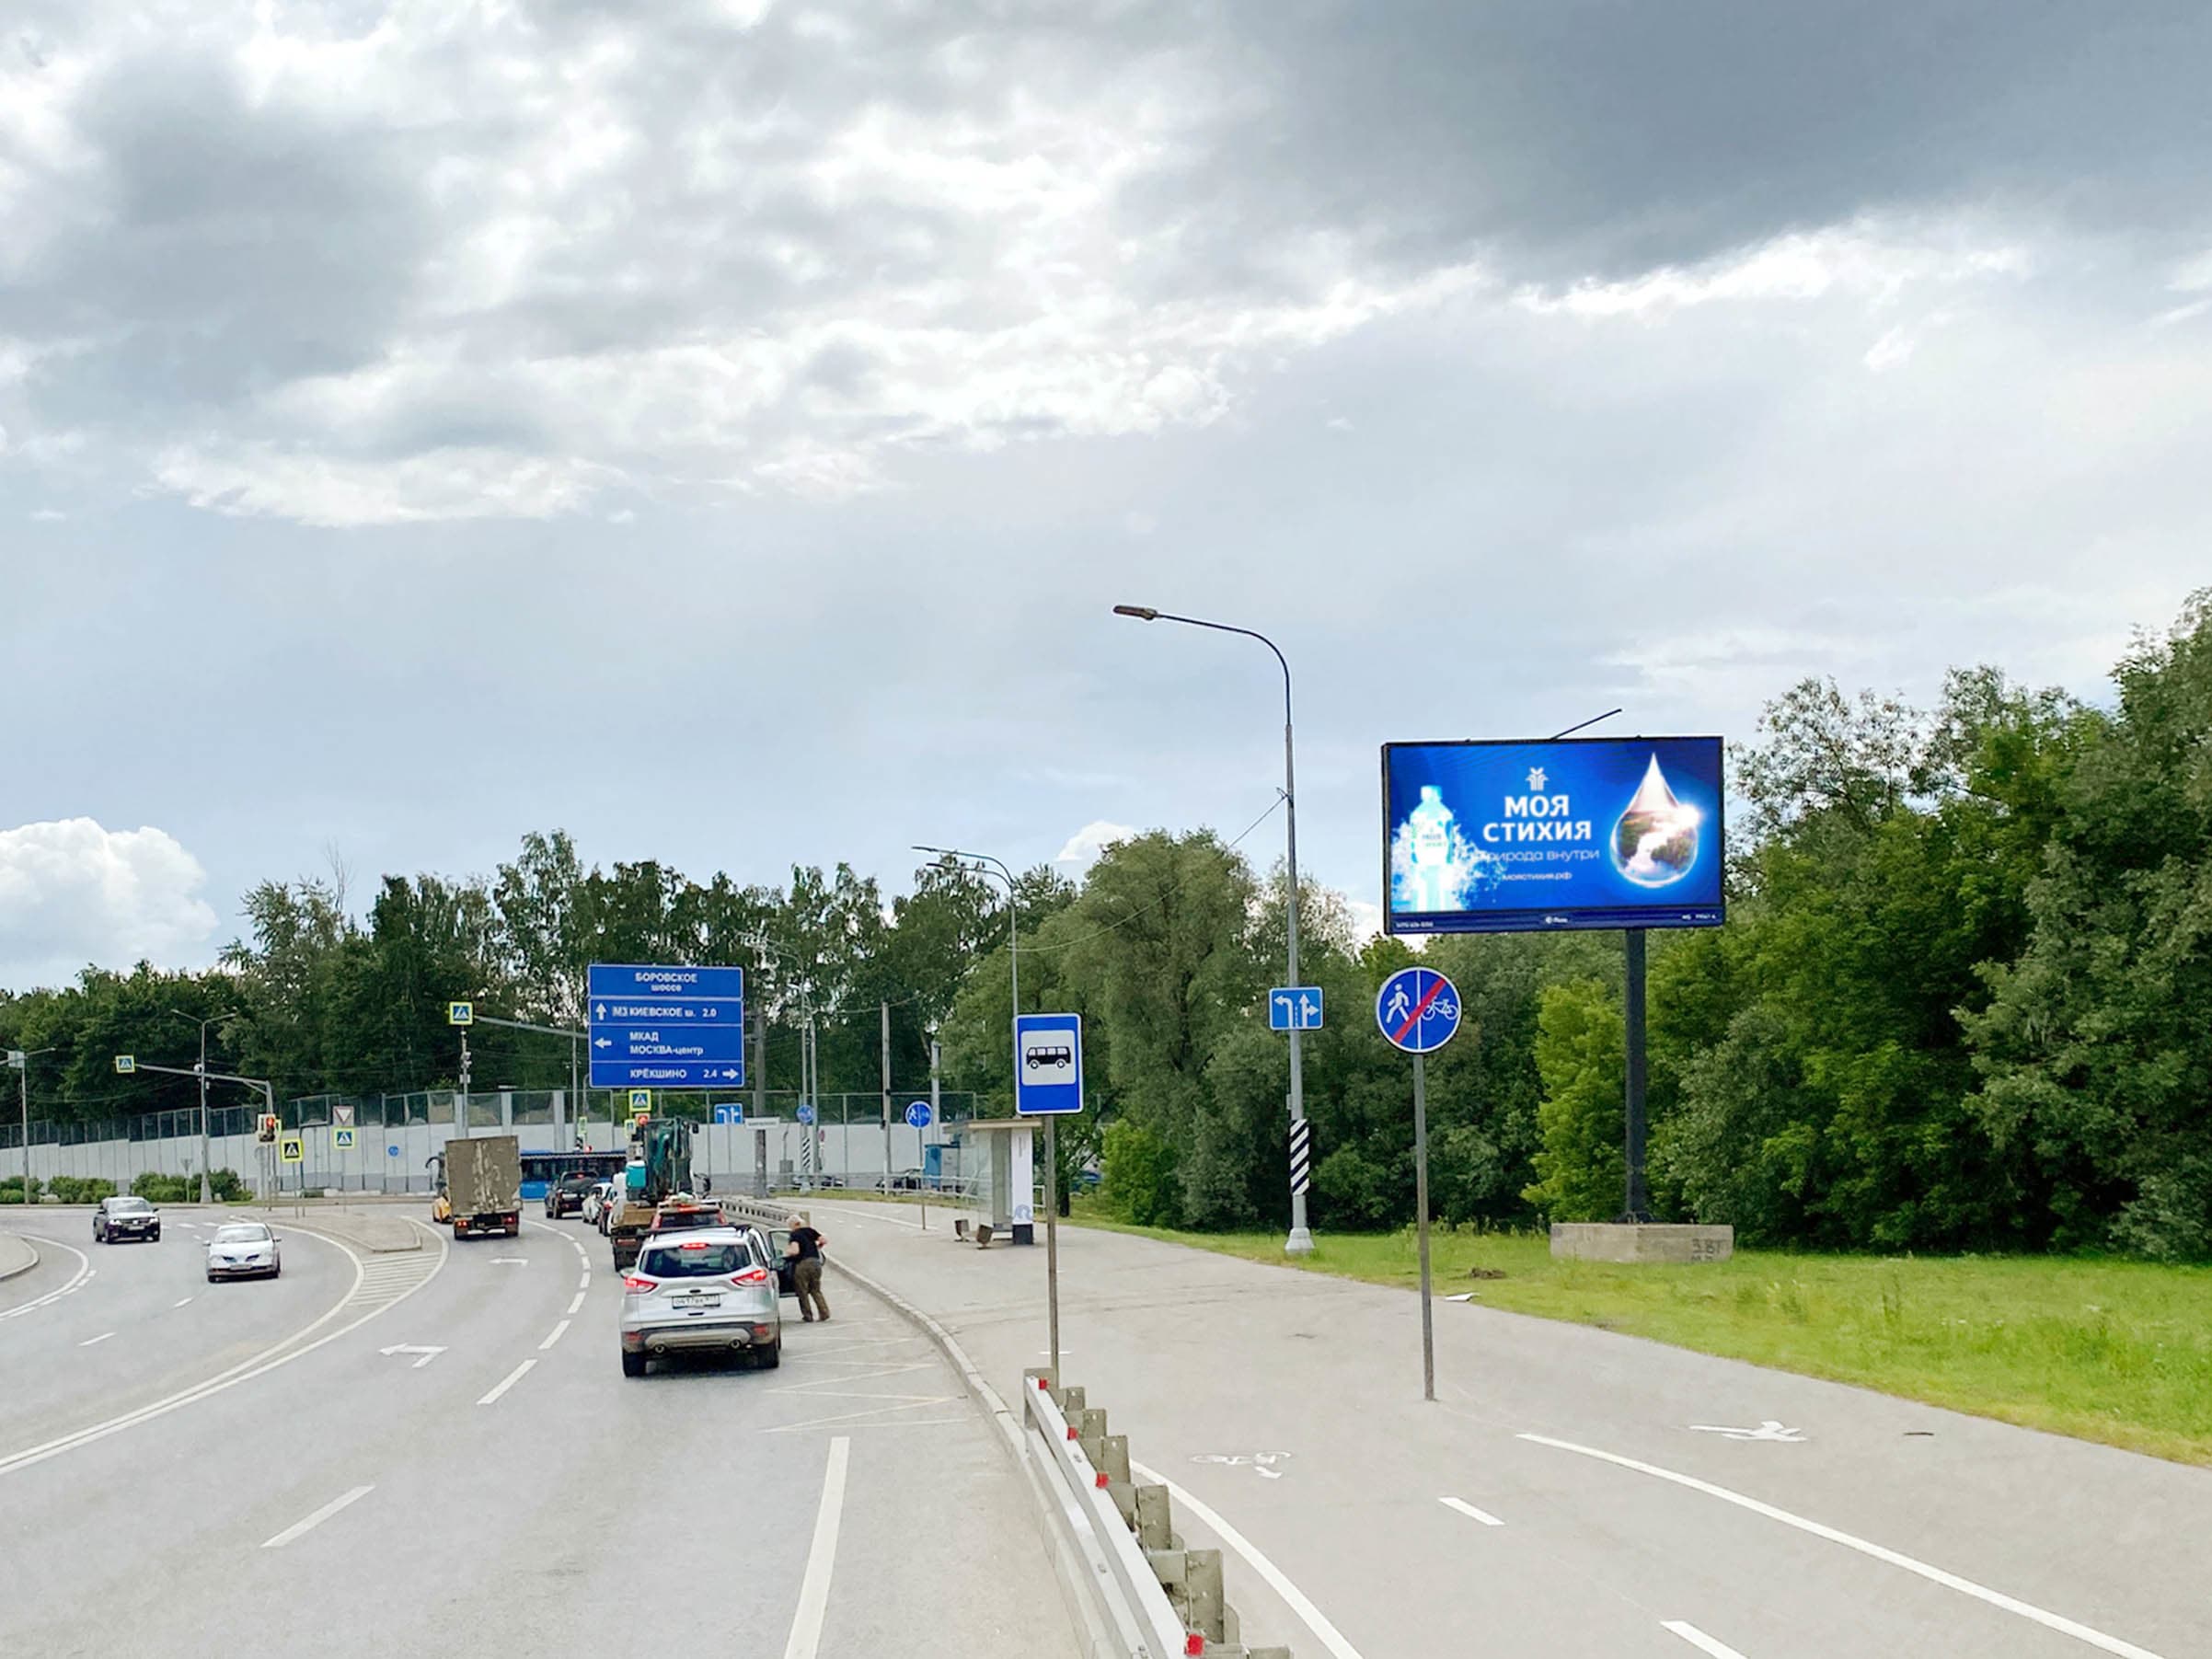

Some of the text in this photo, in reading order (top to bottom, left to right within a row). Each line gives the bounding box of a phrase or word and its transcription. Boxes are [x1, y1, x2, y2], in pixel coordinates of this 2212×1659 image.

[1504, 795, 1569, 818] МОЯ
[1482, 821, 1592, 843] СТИХИЯ
[1547, 849, 1600, 862] внутри
[635, 972, 697, 984] БОРОВСКОЕ
[629, 1007, 683, 1018] КИЕВСКОЕ
[702, 1008, 718, 1018] 2.0
[629, 1031, 660, 1043] МКАД
[629, 1045, 704, 1056] МОСКВА-центр
[703, 1069, 718, 1078] 2.4
